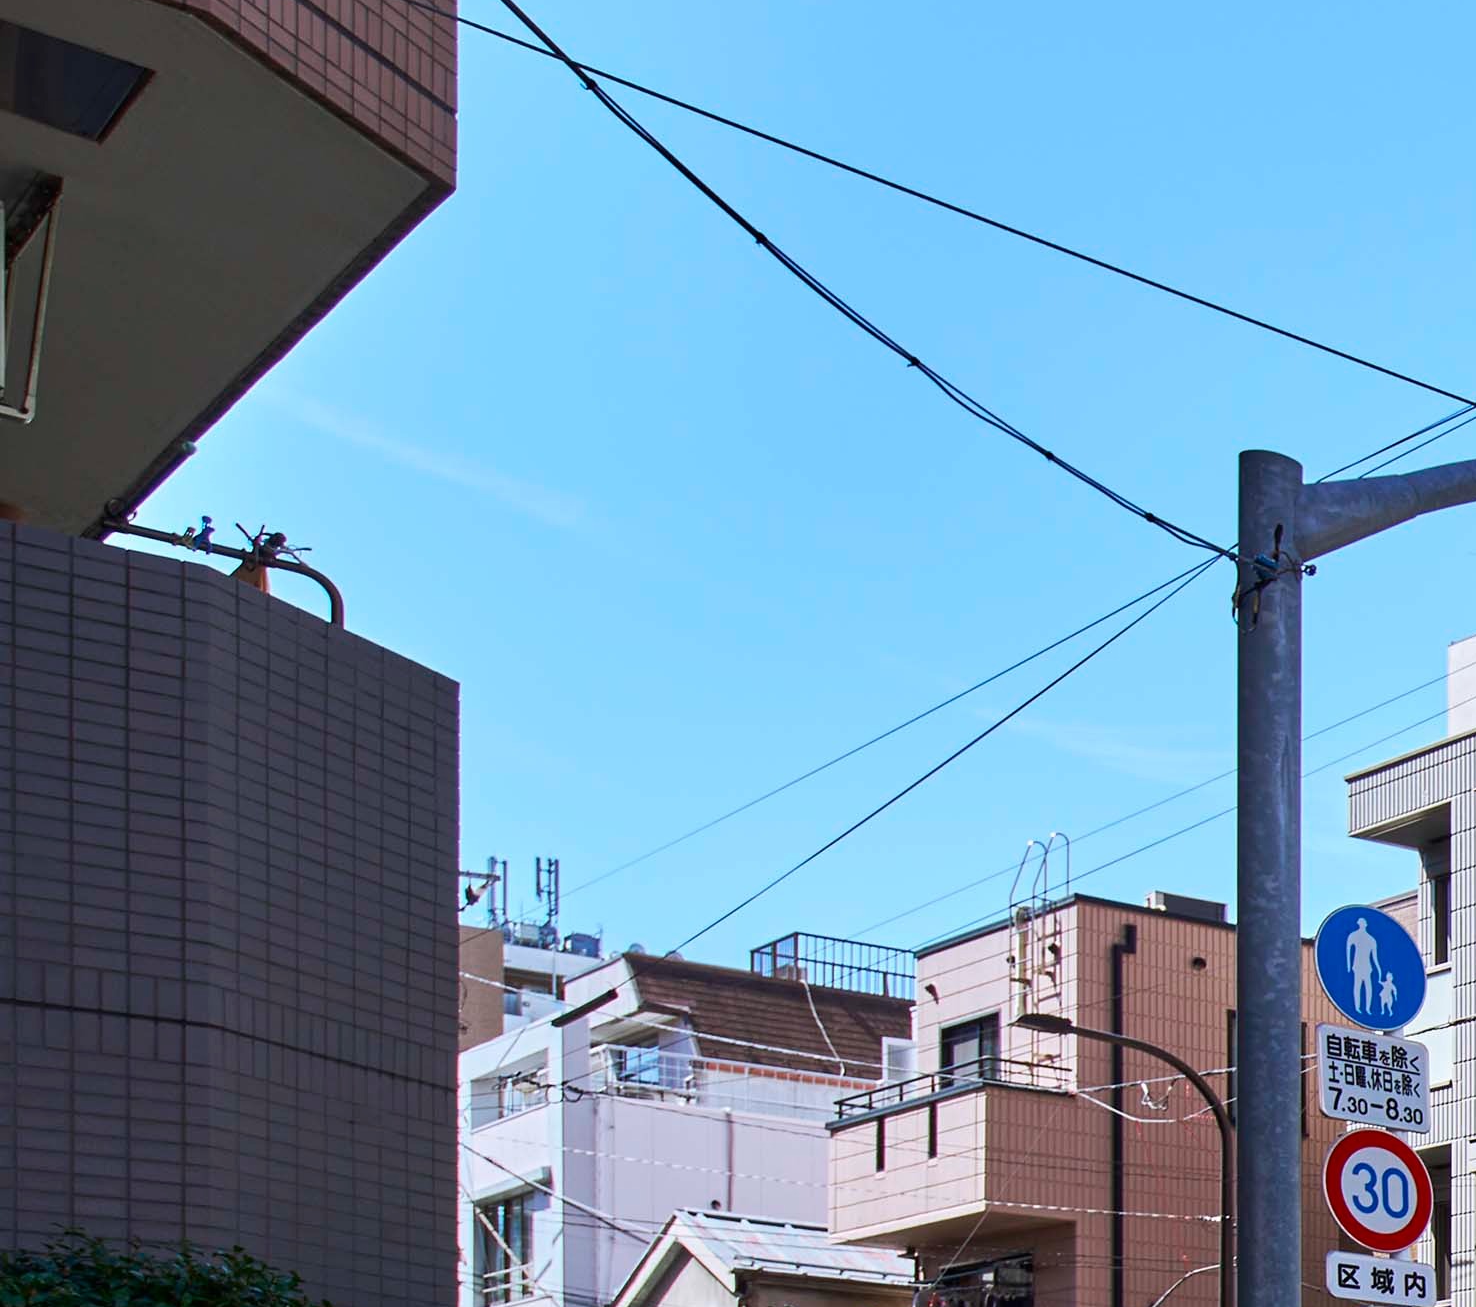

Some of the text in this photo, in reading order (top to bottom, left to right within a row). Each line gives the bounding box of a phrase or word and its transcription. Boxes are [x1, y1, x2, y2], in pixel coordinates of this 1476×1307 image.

[1326, 1033, 1420, 1072] 自転車を除く
[1352, 1162, 1410, 1218] 30
[1337, 1262, 1427, 1300] 区域内
